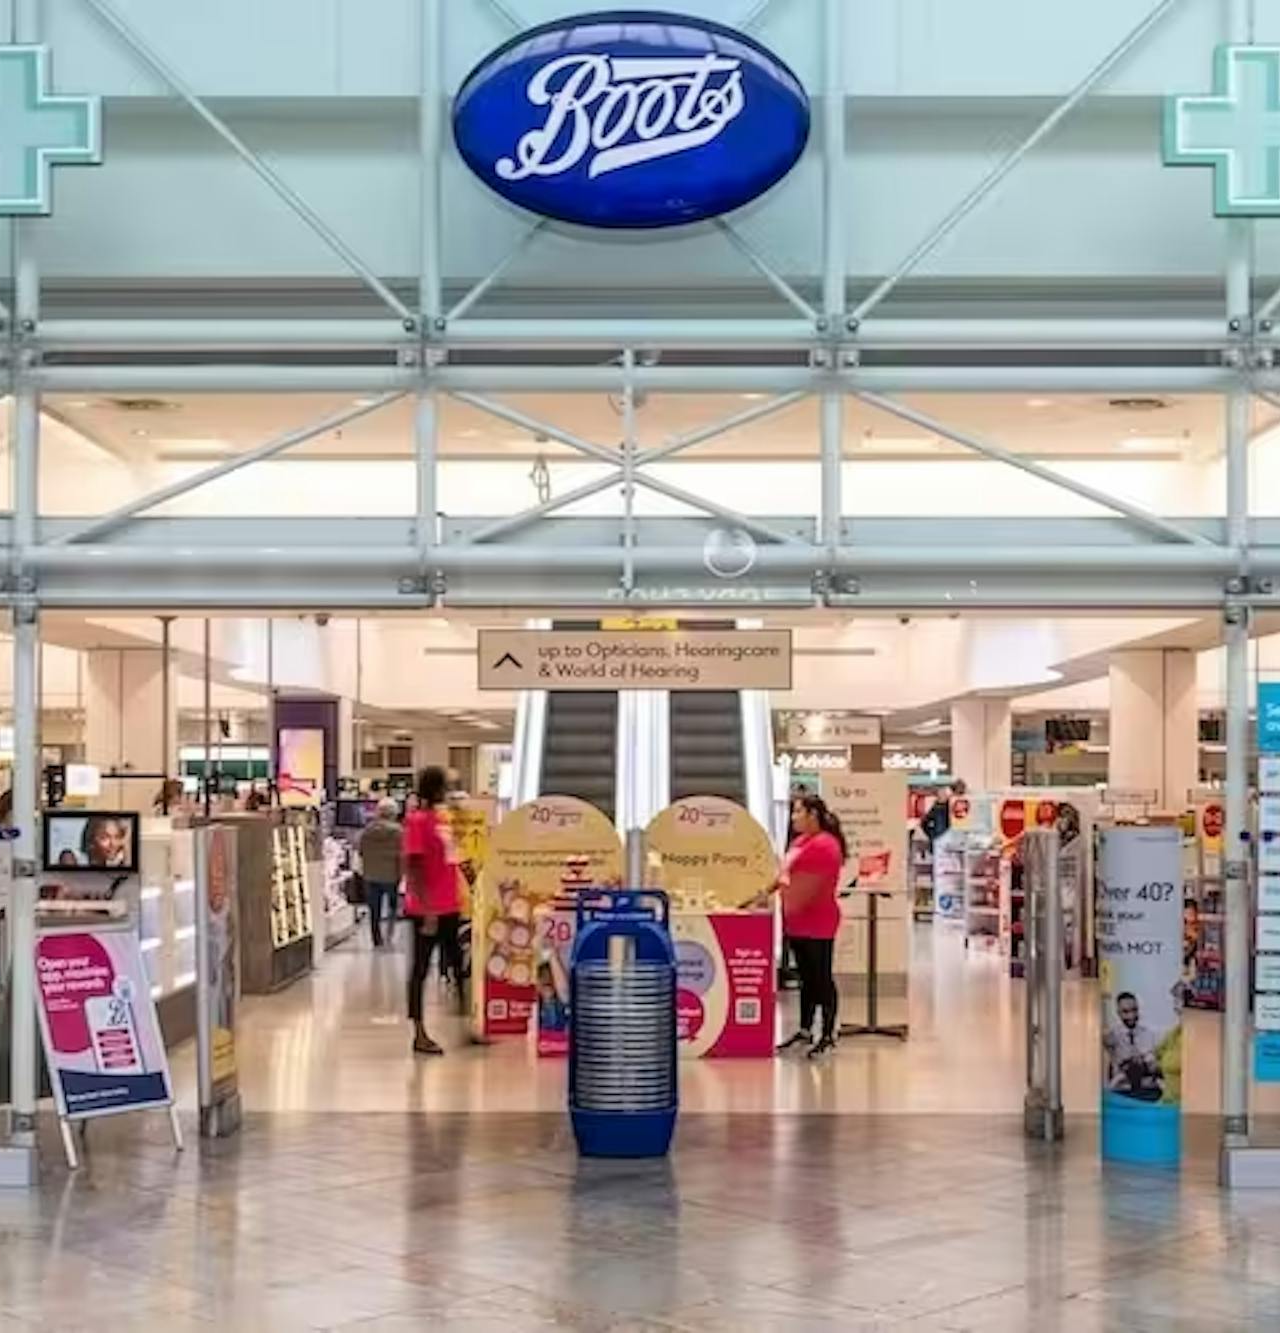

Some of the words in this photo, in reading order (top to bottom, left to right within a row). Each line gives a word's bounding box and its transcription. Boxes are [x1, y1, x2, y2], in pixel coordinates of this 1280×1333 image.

[495, 52, 745, 180] Boots
[537, 646, 560, 661] up
[563, 644, 582, 658] to
[538, 662, 551, 677] &
[555, 662, 606, 678] World
[610, 662, 626, 678] of
[630, 662, 700, 682] Hearing
[1137, 882, 1174, 901] 40?
[543, 918, 571, 941] 20
